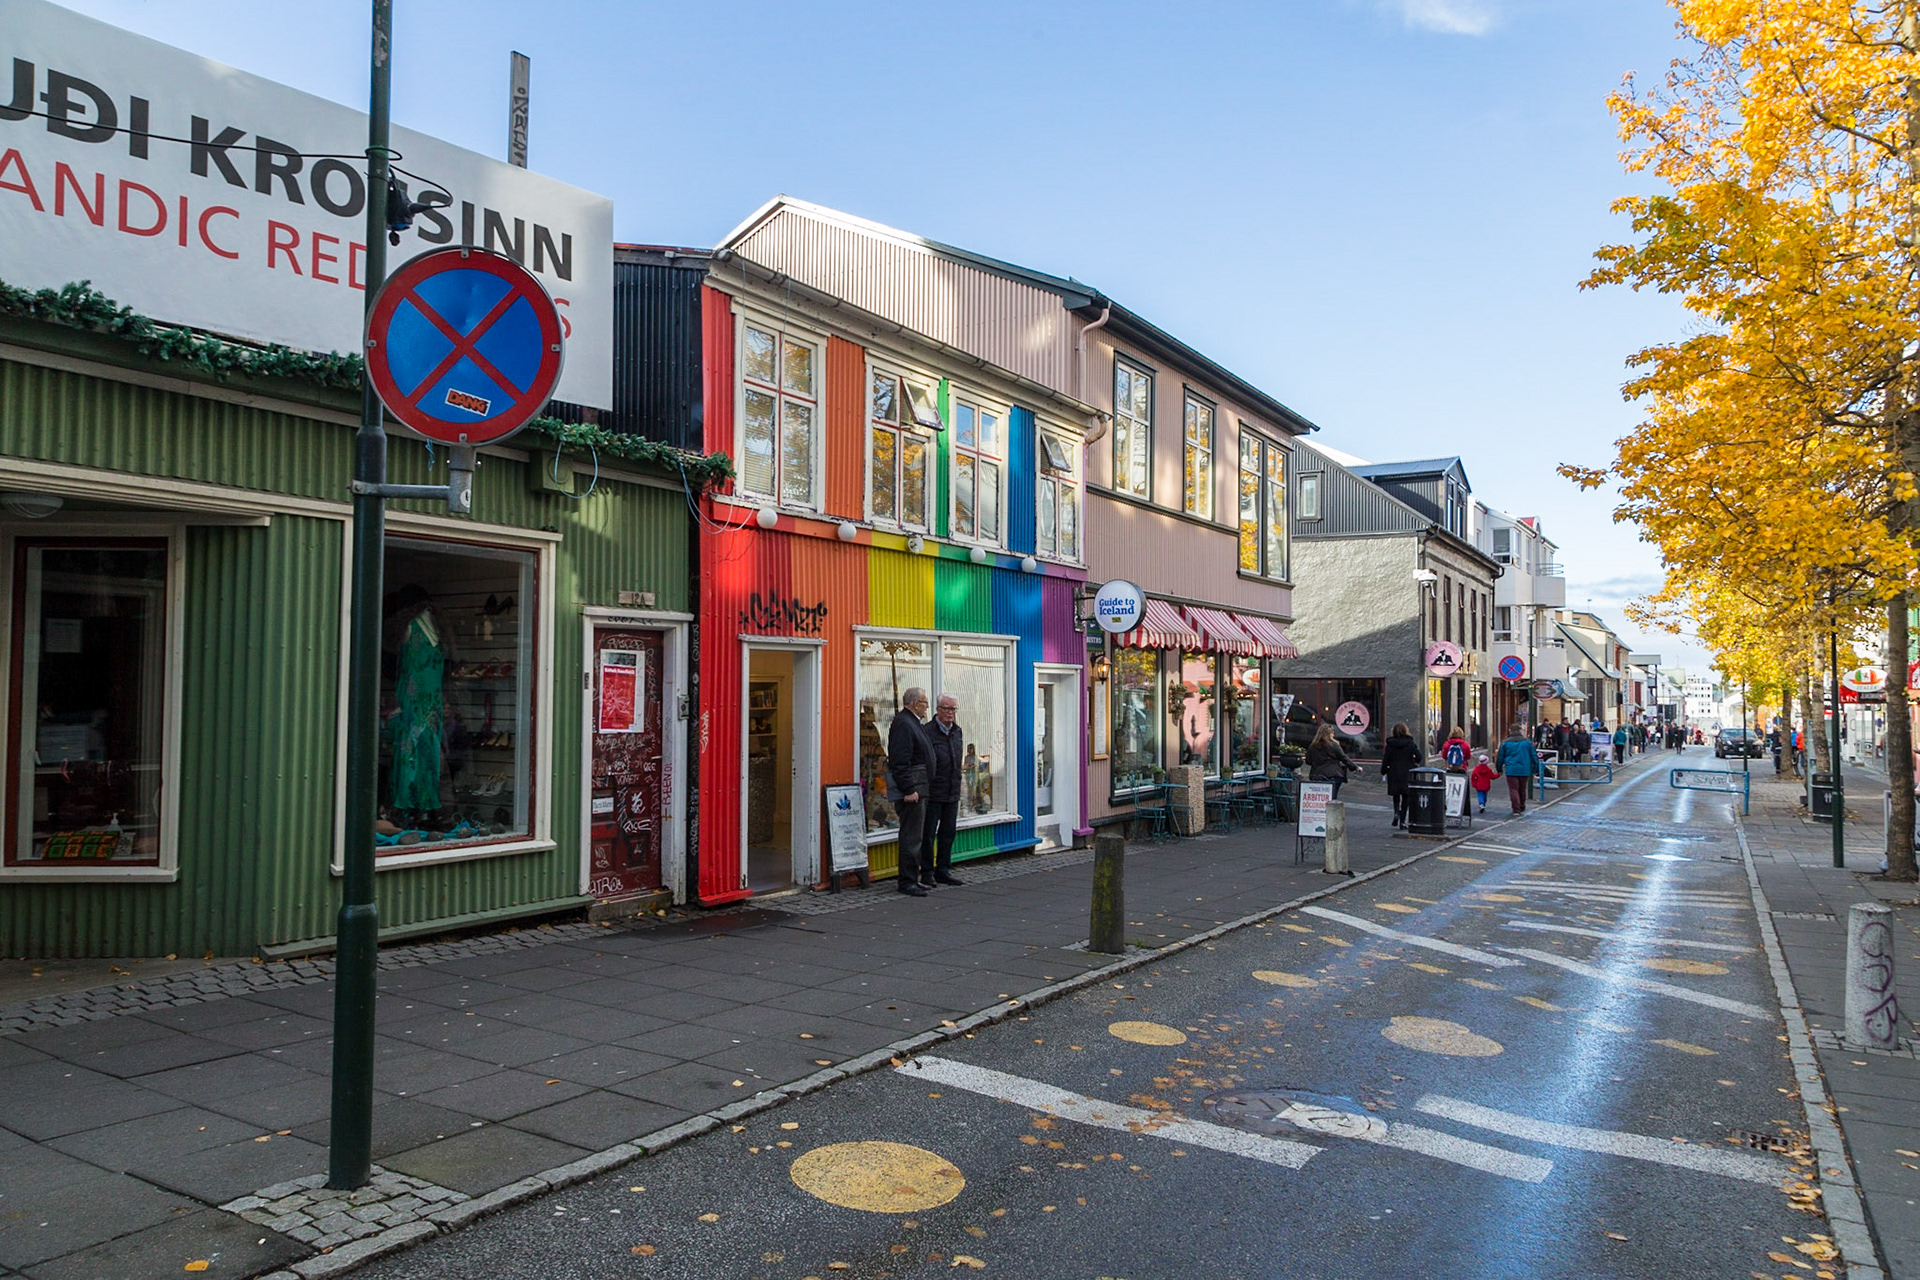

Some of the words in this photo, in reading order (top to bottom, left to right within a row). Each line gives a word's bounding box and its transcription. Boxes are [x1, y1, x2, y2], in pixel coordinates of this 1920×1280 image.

[190, 115, 573, 282] KROSINN
[1099, 597, 1123, 606] Guide
[1125, 598, 1135, 606] to
[1099, 605, 1135, 615] Iceland
